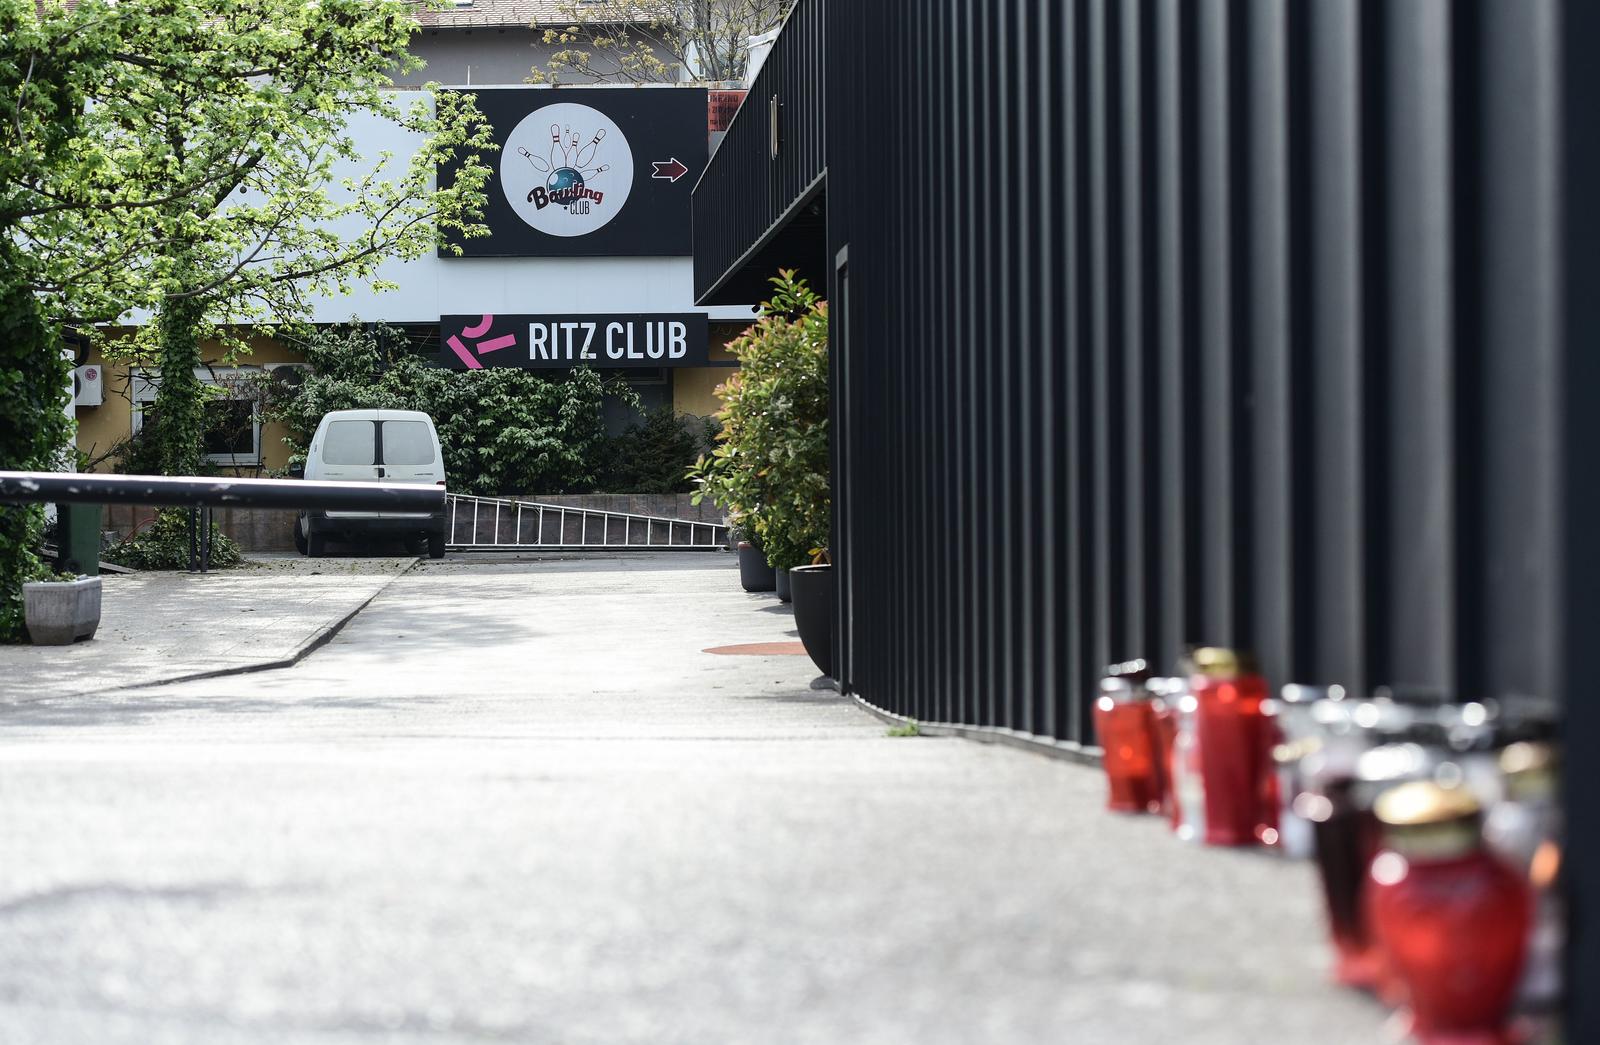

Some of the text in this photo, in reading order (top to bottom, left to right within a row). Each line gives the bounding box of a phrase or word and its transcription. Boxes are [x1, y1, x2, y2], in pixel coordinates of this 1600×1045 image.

[527, 183, 604, 210] Bowling
[570, 200, 590, 215] CLUB
[529, 321, 687, 360] RITZ CLUB
